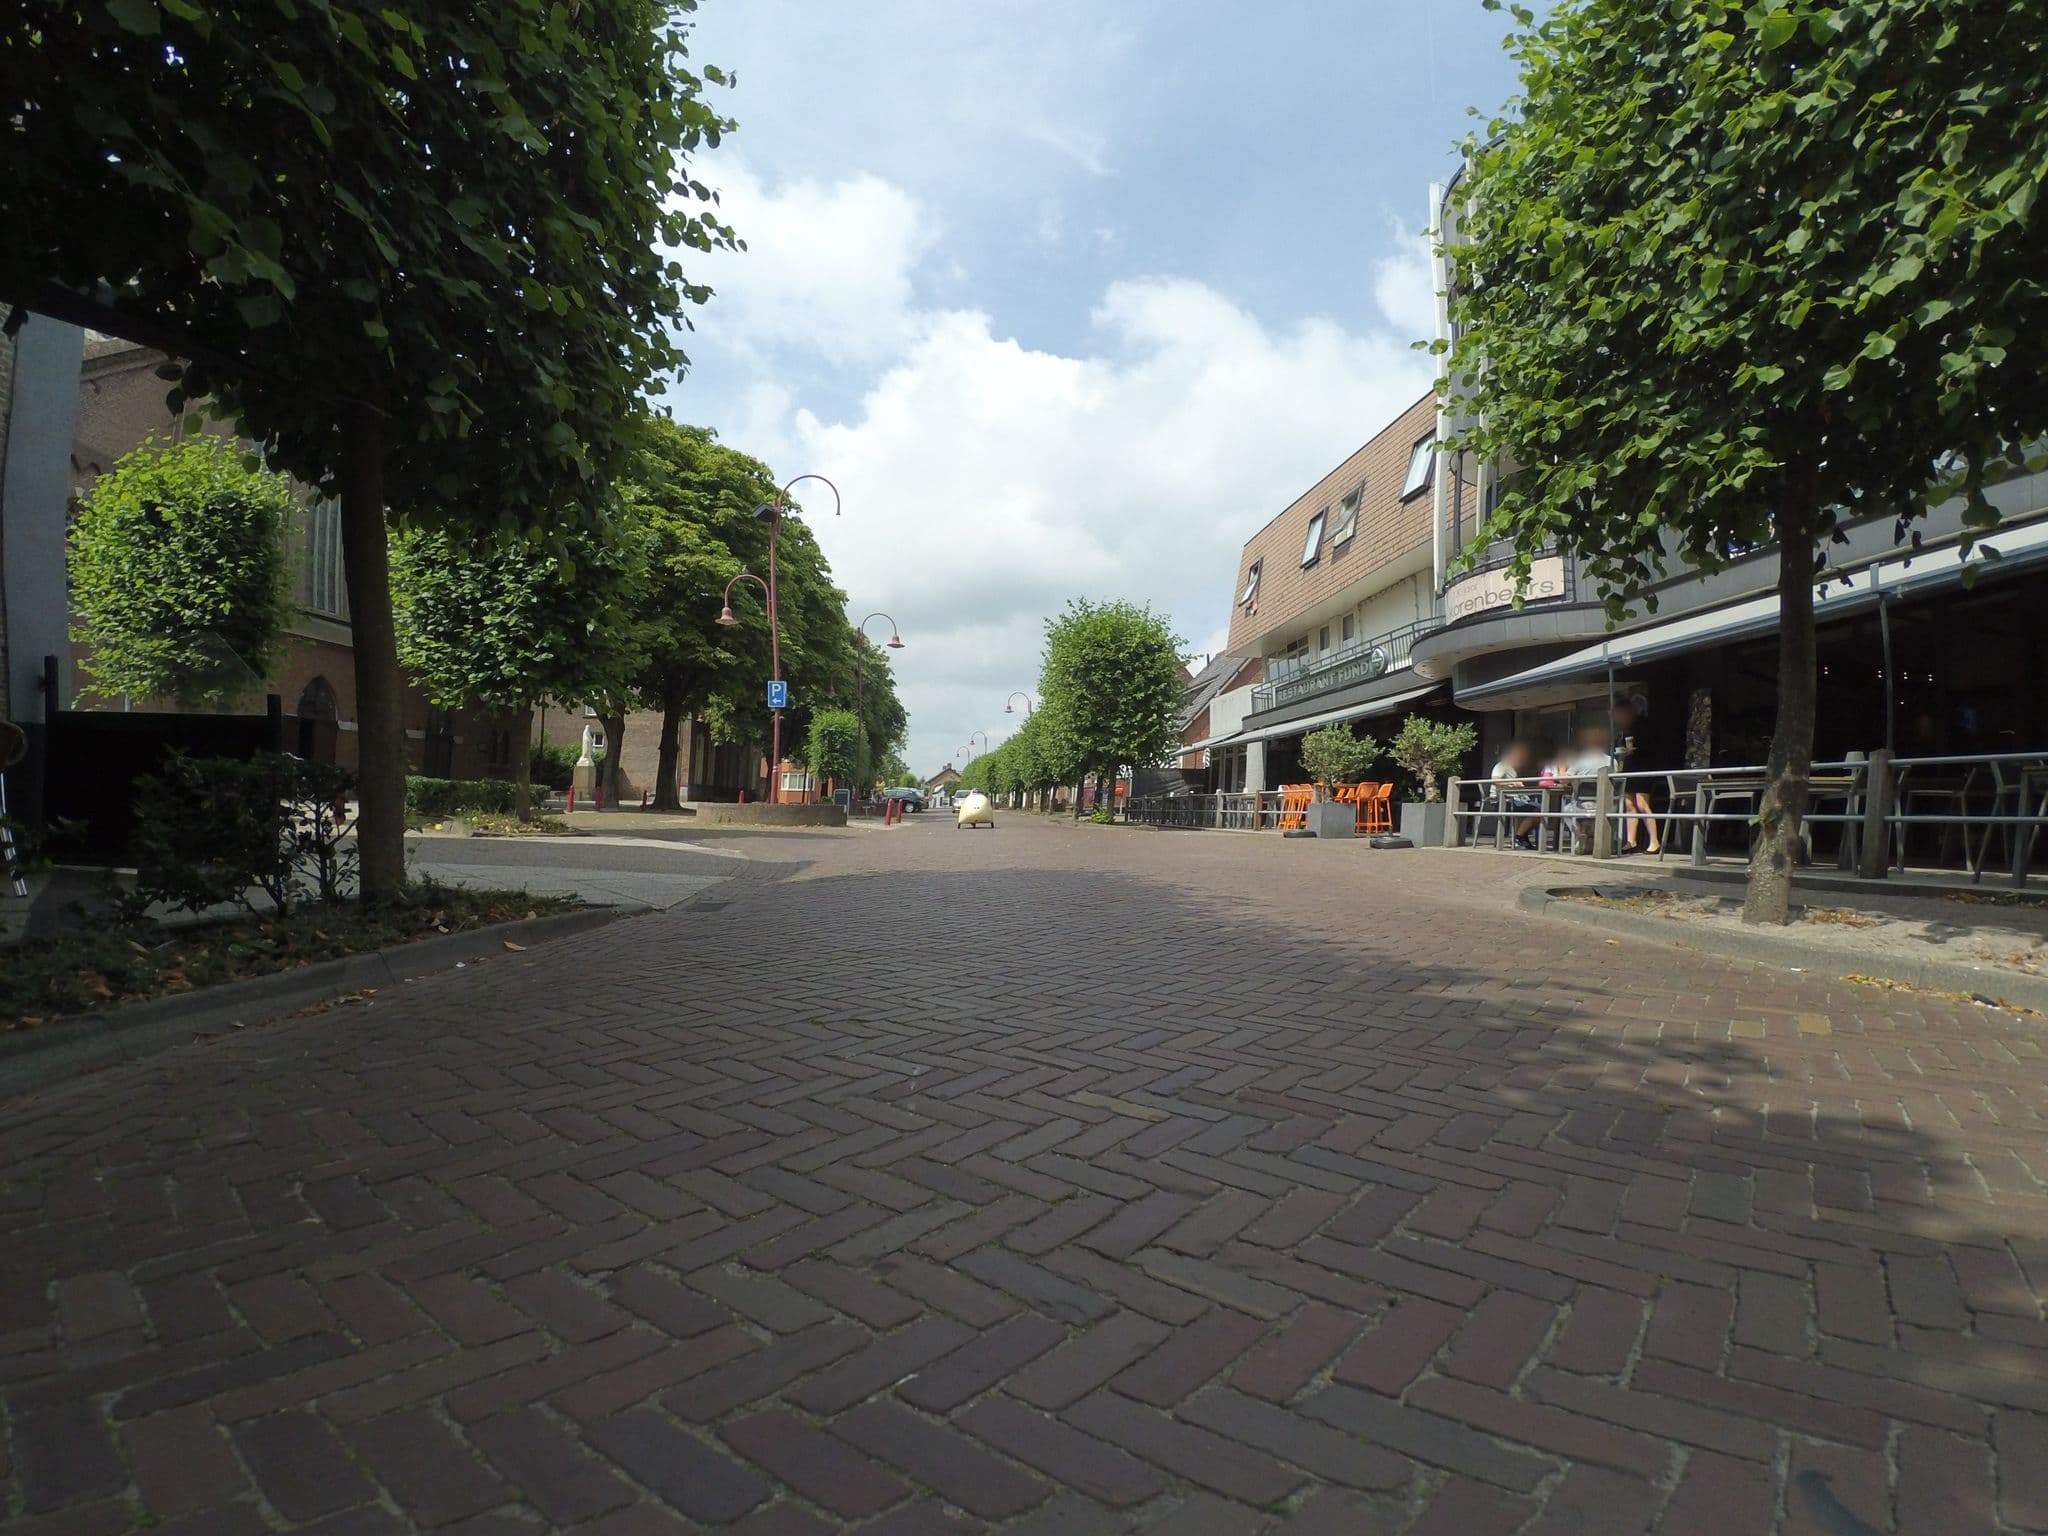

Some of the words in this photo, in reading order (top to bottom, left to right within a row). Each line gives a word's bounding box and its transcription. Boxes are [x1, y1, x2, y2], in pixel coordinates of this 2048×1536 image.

[1448, 580, 1554, 619] korenbers
[772, 684, 781, 696] P
[1279, 675, 1337, 701] RESTAURANT
